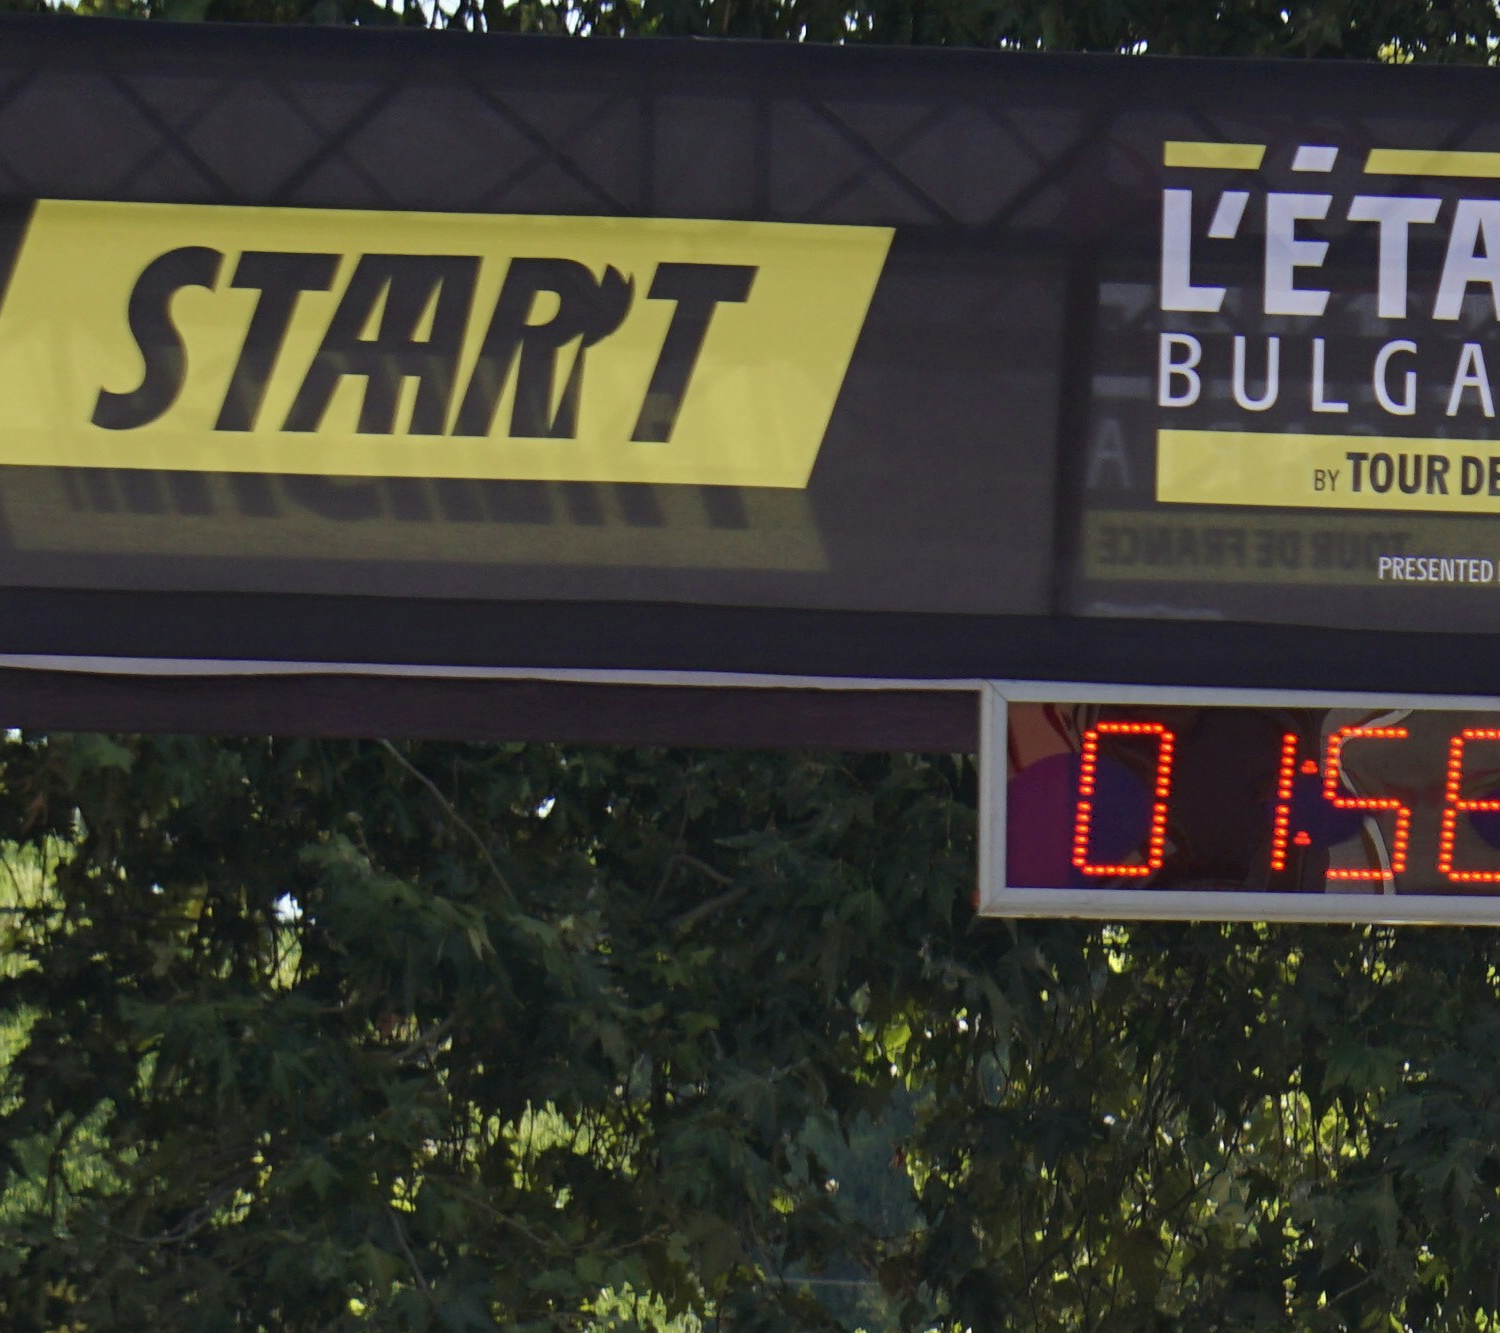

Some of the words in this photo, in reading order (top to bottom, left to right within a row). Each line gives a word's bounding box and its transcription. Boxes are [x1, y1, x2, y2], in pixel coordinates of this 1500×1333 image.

[90, 245, 759, 445] START
[1313, 469, 1340, 493] BY
[1346, 451, 1450, 498] TOUR
[1378, 555, 1493, 585] PRESENTED
